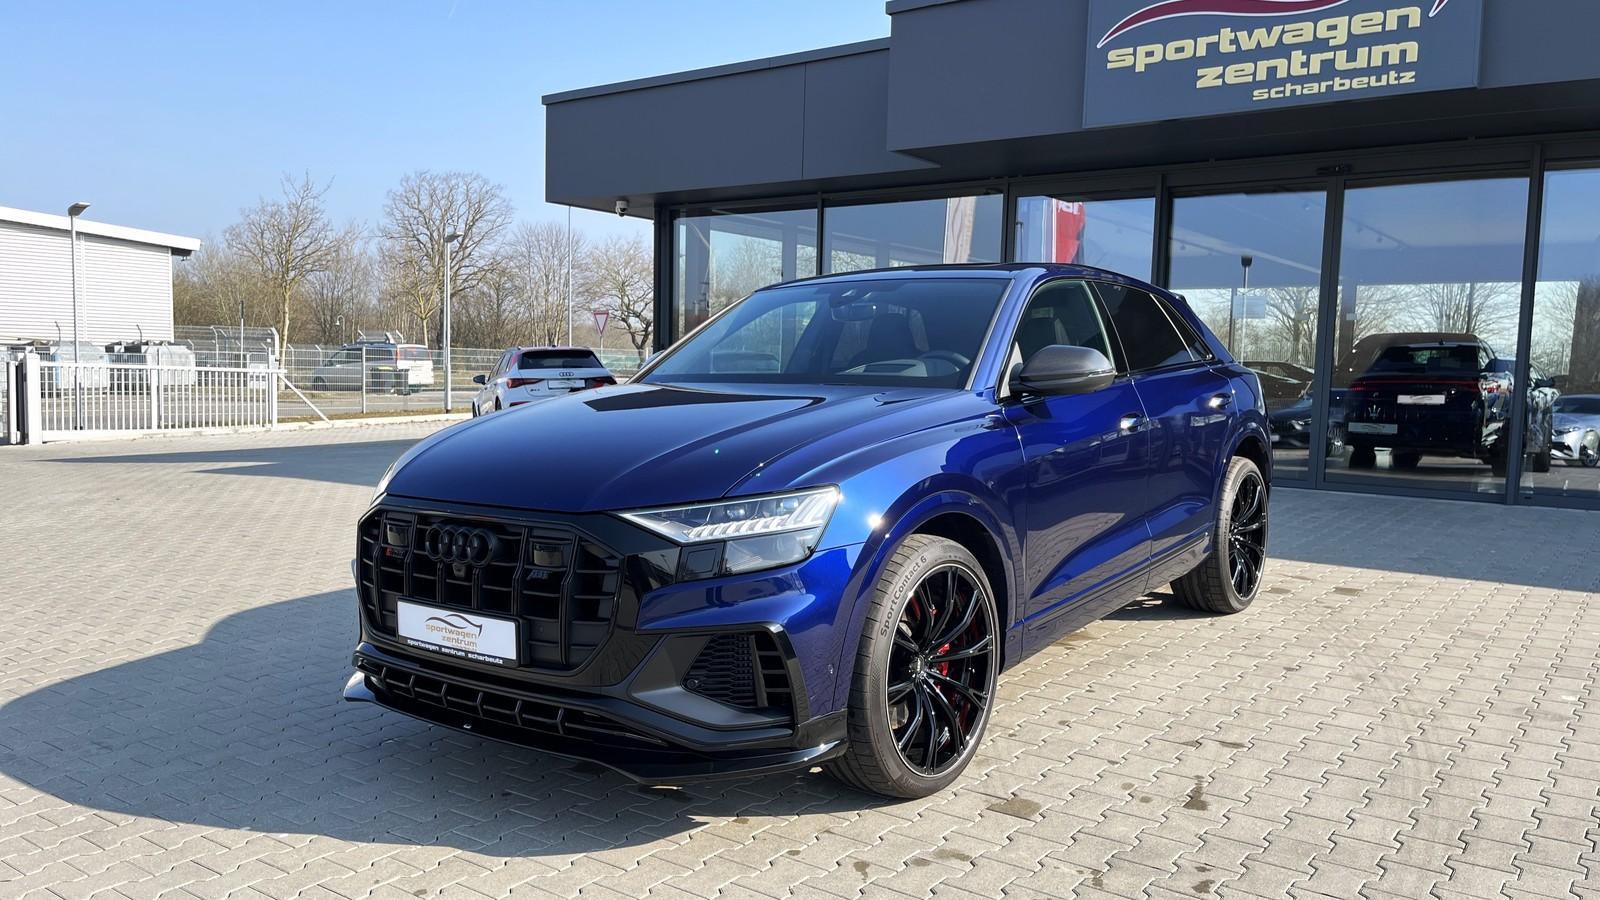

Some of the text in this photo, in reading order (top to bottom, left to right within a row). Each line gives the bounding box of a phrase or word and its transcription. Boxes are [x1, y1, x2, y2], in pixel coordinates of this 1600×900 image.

[1107, 7, 1421, 72] sportwagen
[1196, 41, 1418, 88] zentrum
[1253, 71, 1415, 100] scharbeutz
[881, 555, 927, 637] SportContact 6
[426, 624, 477, 639] sportwagen
[441, 635, 478, 648] zentrum
